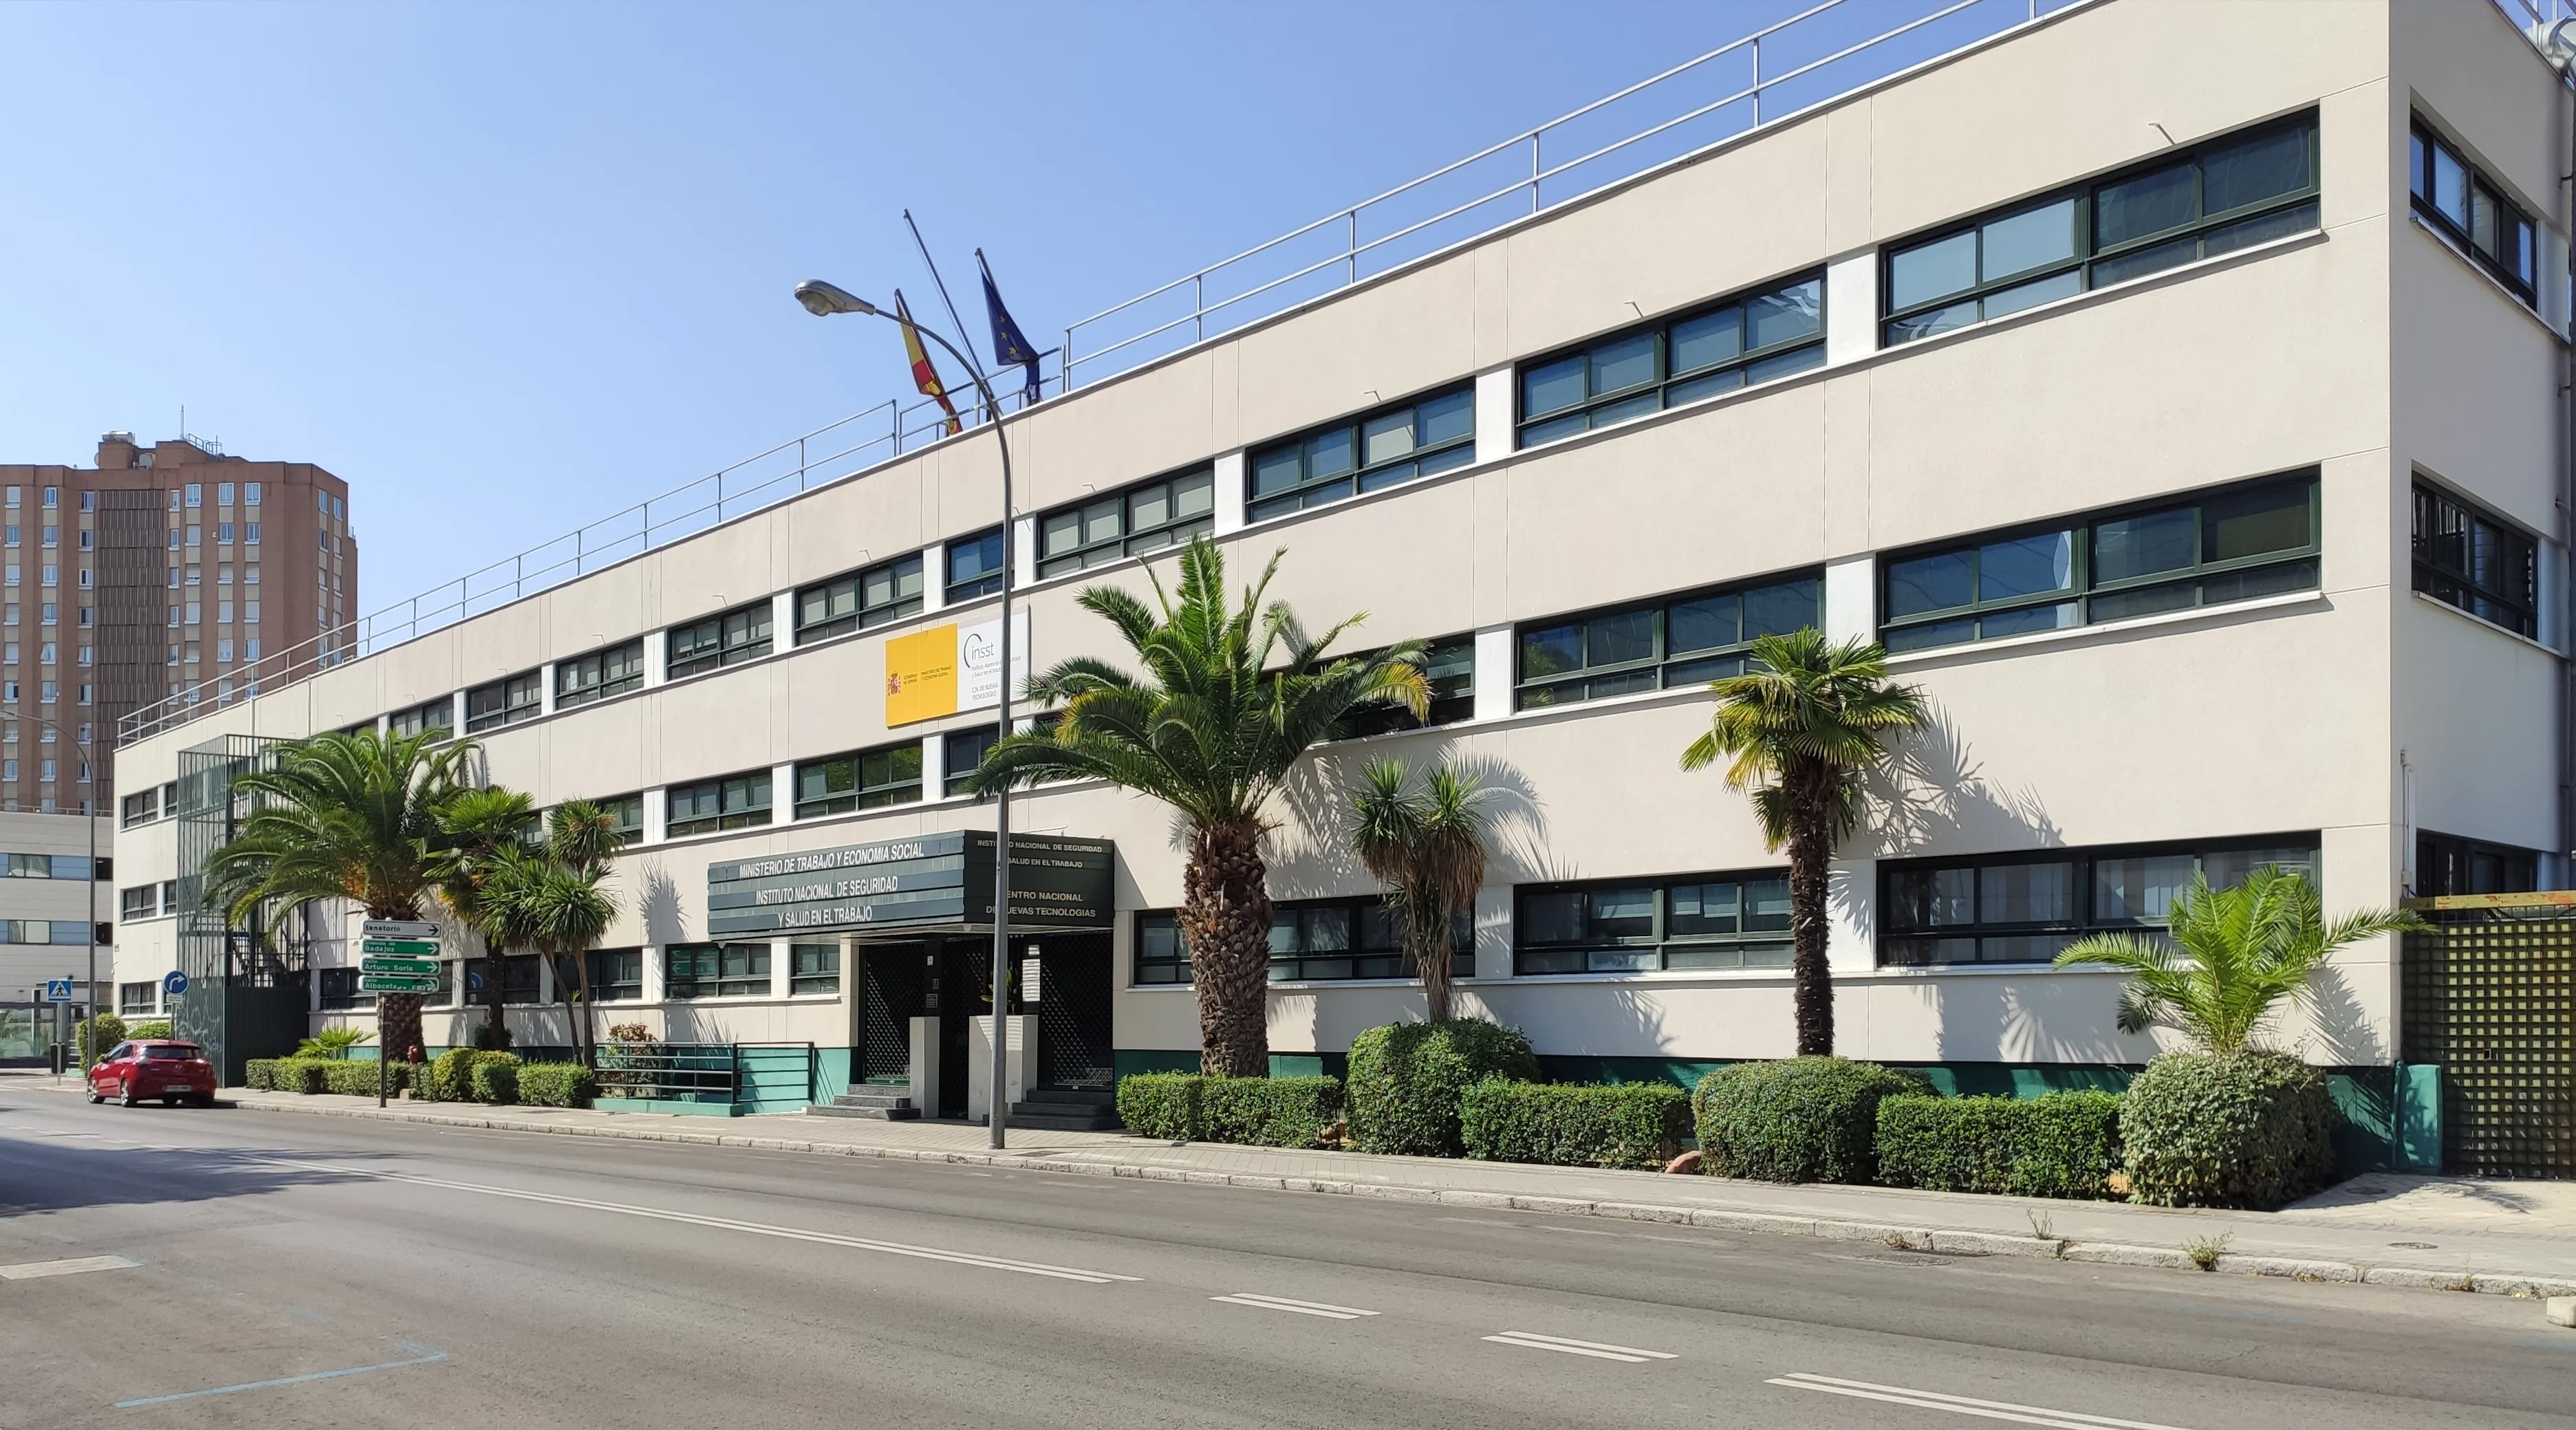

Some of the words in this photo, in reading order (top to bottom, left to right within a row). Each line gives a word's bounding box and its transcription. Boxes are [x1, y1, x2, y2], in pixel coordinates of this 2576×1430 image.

[972, 642, 995, 660] insst
[977, 839, 1014, 848] INSTIO
[1015, 842, 1050, 850] NACIONAL
[1064, 845, 1102, 853] SEGURIDAD
[739, 860, 783, 878] MINISTERIO
[784, 858, 794, 873] DE
[797, 852, 835, 871] TRABAJO
[836, 852, 843, 866] Y
[843, 846, 889, 865] ECONOMIA
[891, 842, 924, 860] SOCIAL
[756, 887, 793, 904] INSTITUTO
[794, 883, 834, 902] NACIONAL
[837, 881, 847, 896] DE
[849, 876, 898, 896] SEGURIDAD
[1008, 891, 1036, 900] ENTRO
[1039, 892, 1083, 902] NACIONAL
[778, 913, 784, 928] Y
[786, 910, 810, 927] SALUD
[811, 909, 821, 924] EN
[823, 908, 834, 924] EL
[834, 905, 872, 923] TRABAJO
[1008, 906, 1034, 916] UEVAS
[1035, 907, 1096, 917] TECNOLOGIAS
